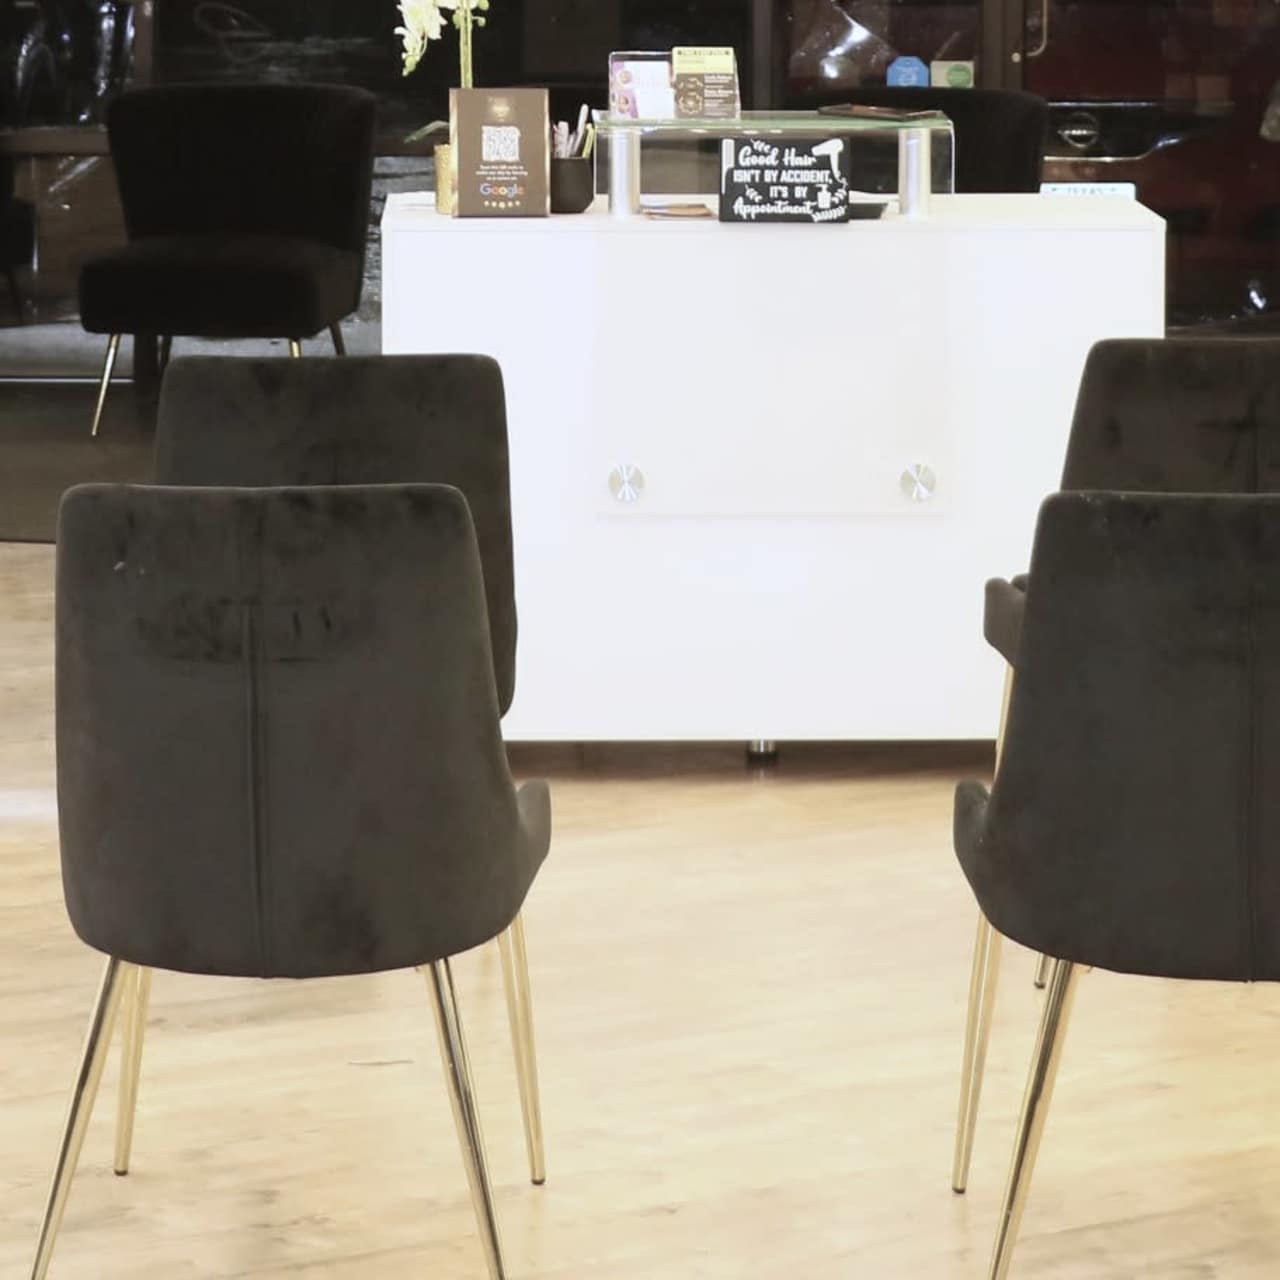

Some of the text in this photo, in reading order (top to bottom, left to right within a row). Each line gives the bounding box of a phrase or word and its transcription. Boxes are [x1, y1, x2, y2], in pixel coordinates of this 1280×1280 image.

[738, 145, 817, 167] Good Hair
[733, 170, 761, 183] ISN'T
[764, 170, 779, 183] BY
[480, 183, 525, 198] Google
[769, 185, 809, 198] IT'S BY
[733, 196, 817, 220] Appointment
